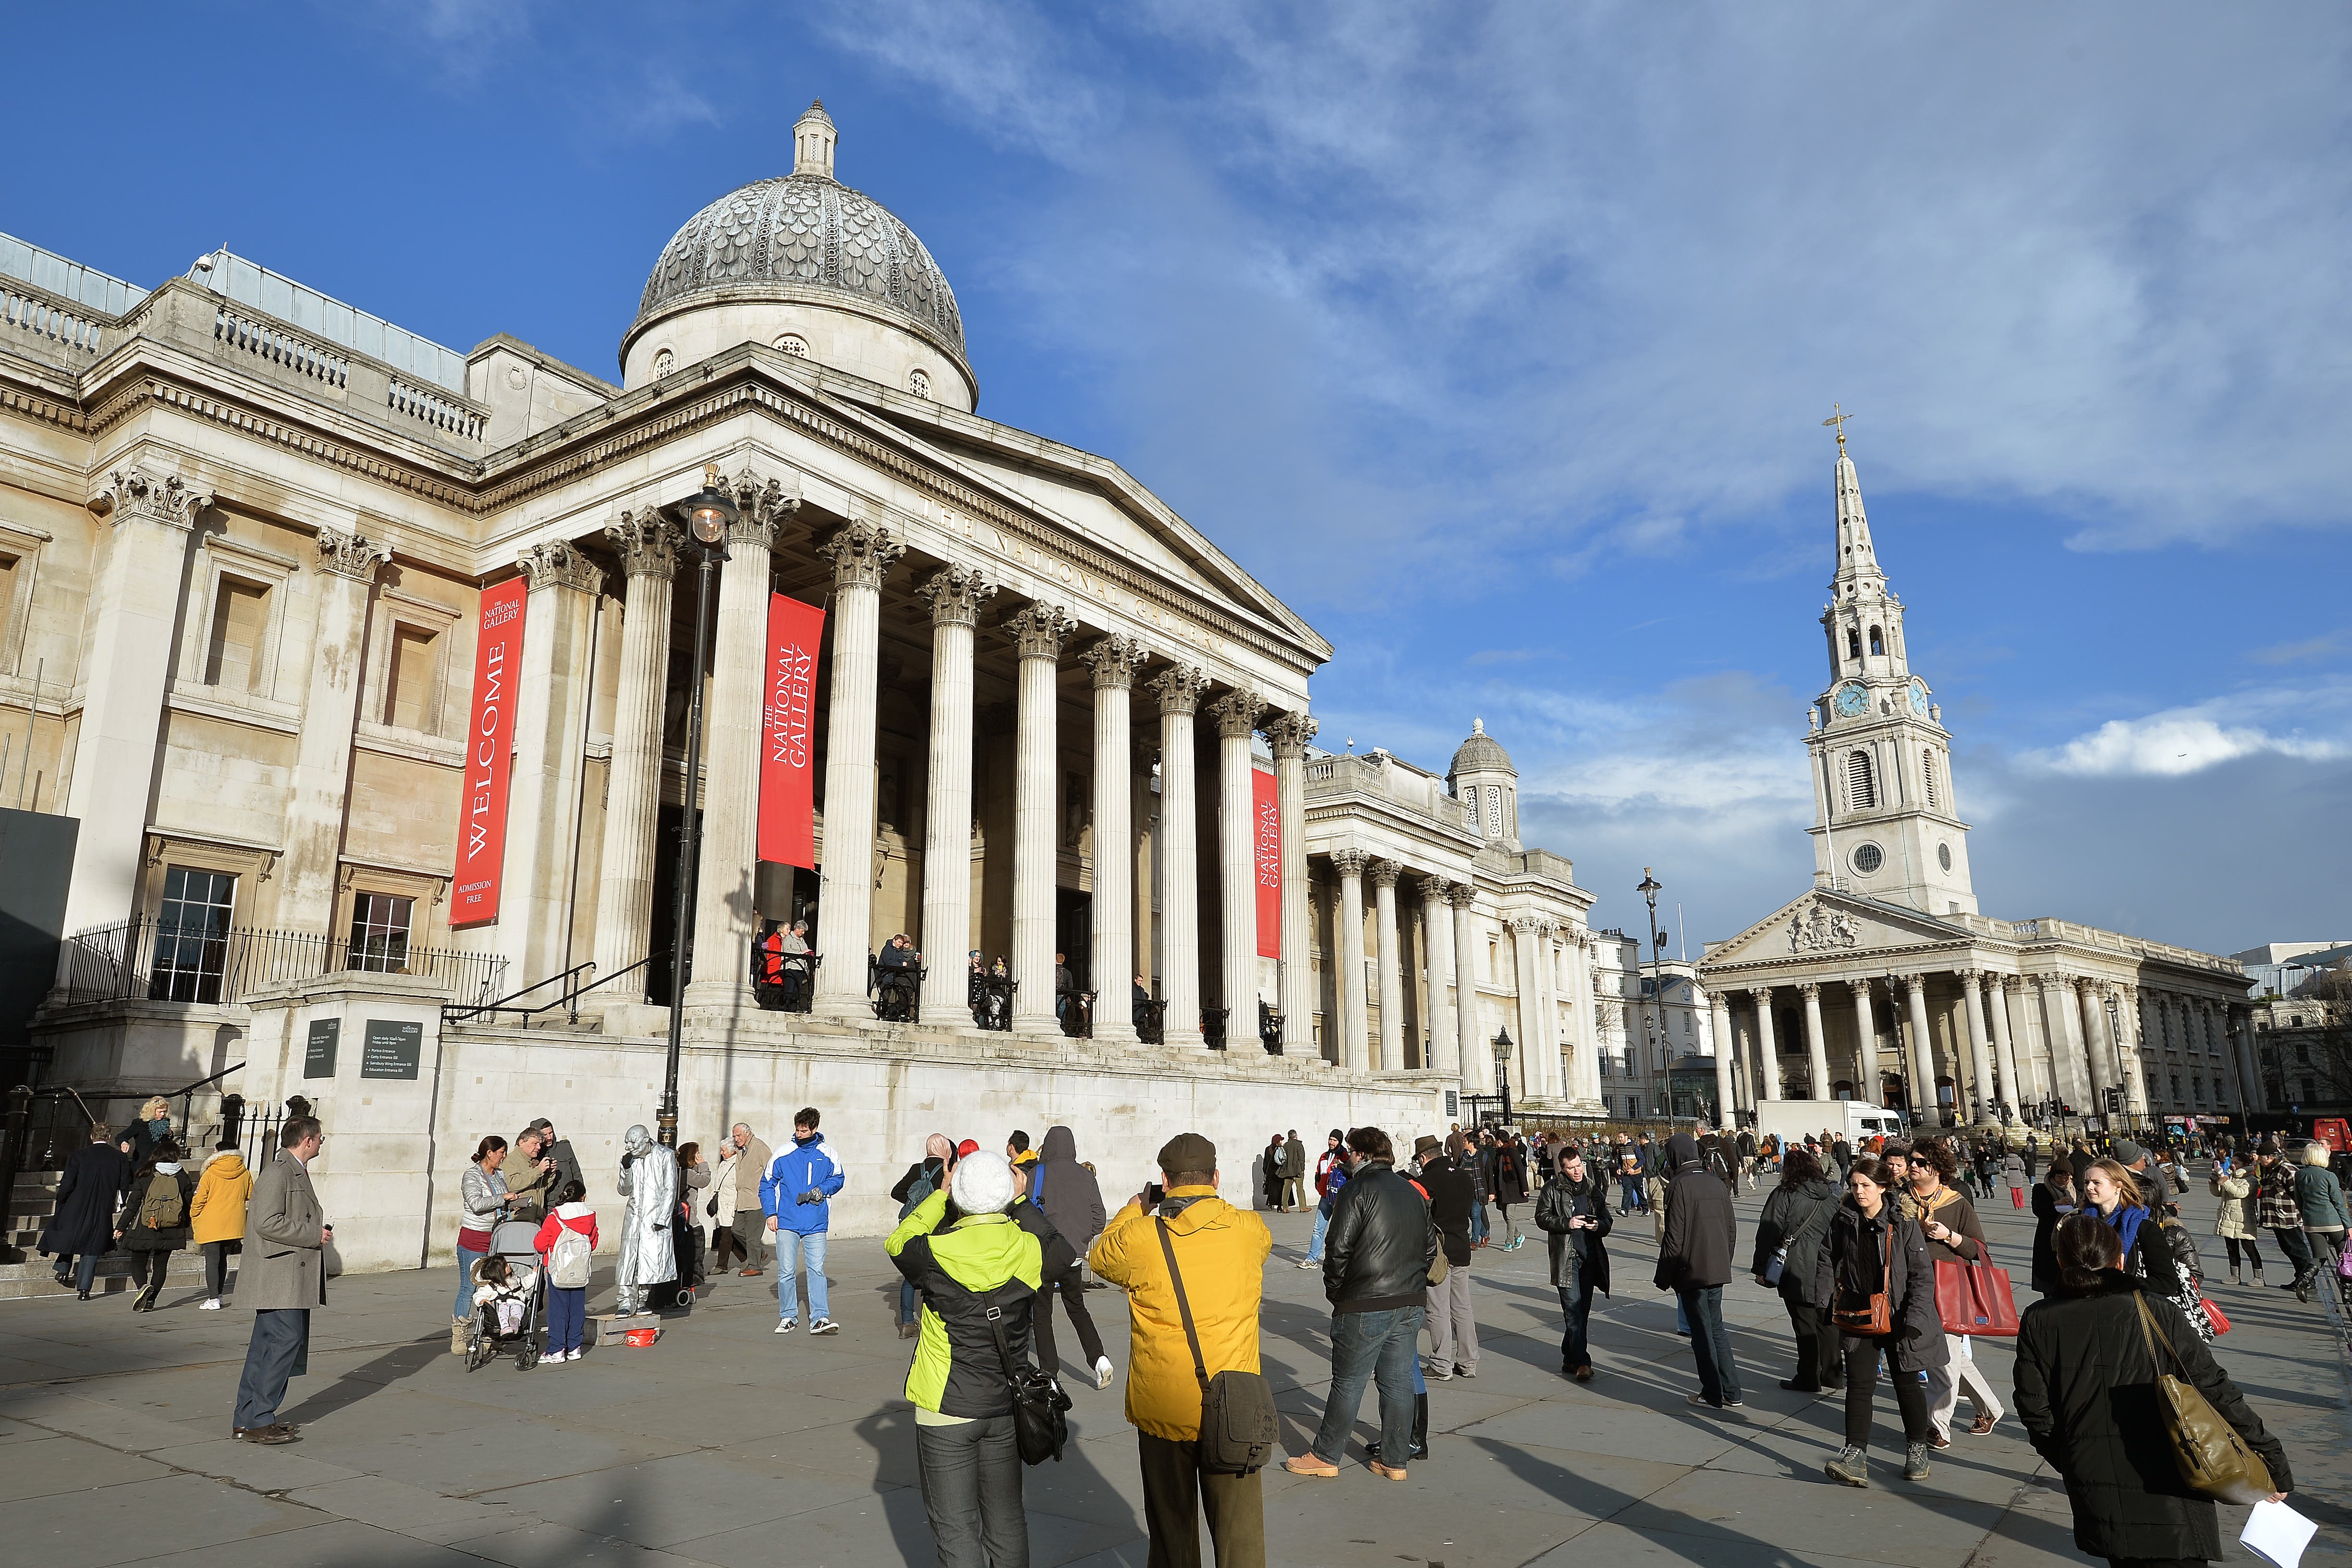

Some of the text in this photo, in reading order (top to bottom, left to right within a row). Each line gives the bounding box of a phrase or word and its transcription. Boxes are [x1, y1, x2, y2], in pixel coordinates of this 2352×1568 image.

[484, 608, 519, 629] GALLERY
[485, 599, 519, 619] NATIONAL
[773, 643, 794, 765] NATIONAL
[790, 645, 811, 768] GALLERY
[765, 705, 773, 728] THE
[468, 641, 505, 863] WELCOME
[1260, 800, 1268, 886] NATIONAL
[1269, 802, 1279, 888] GALLERY
[458, 880, 492, 893] ADMISSION
[466, 894, 482, 904] FREE
[1775, 967, 1806, 975] MARTINI
